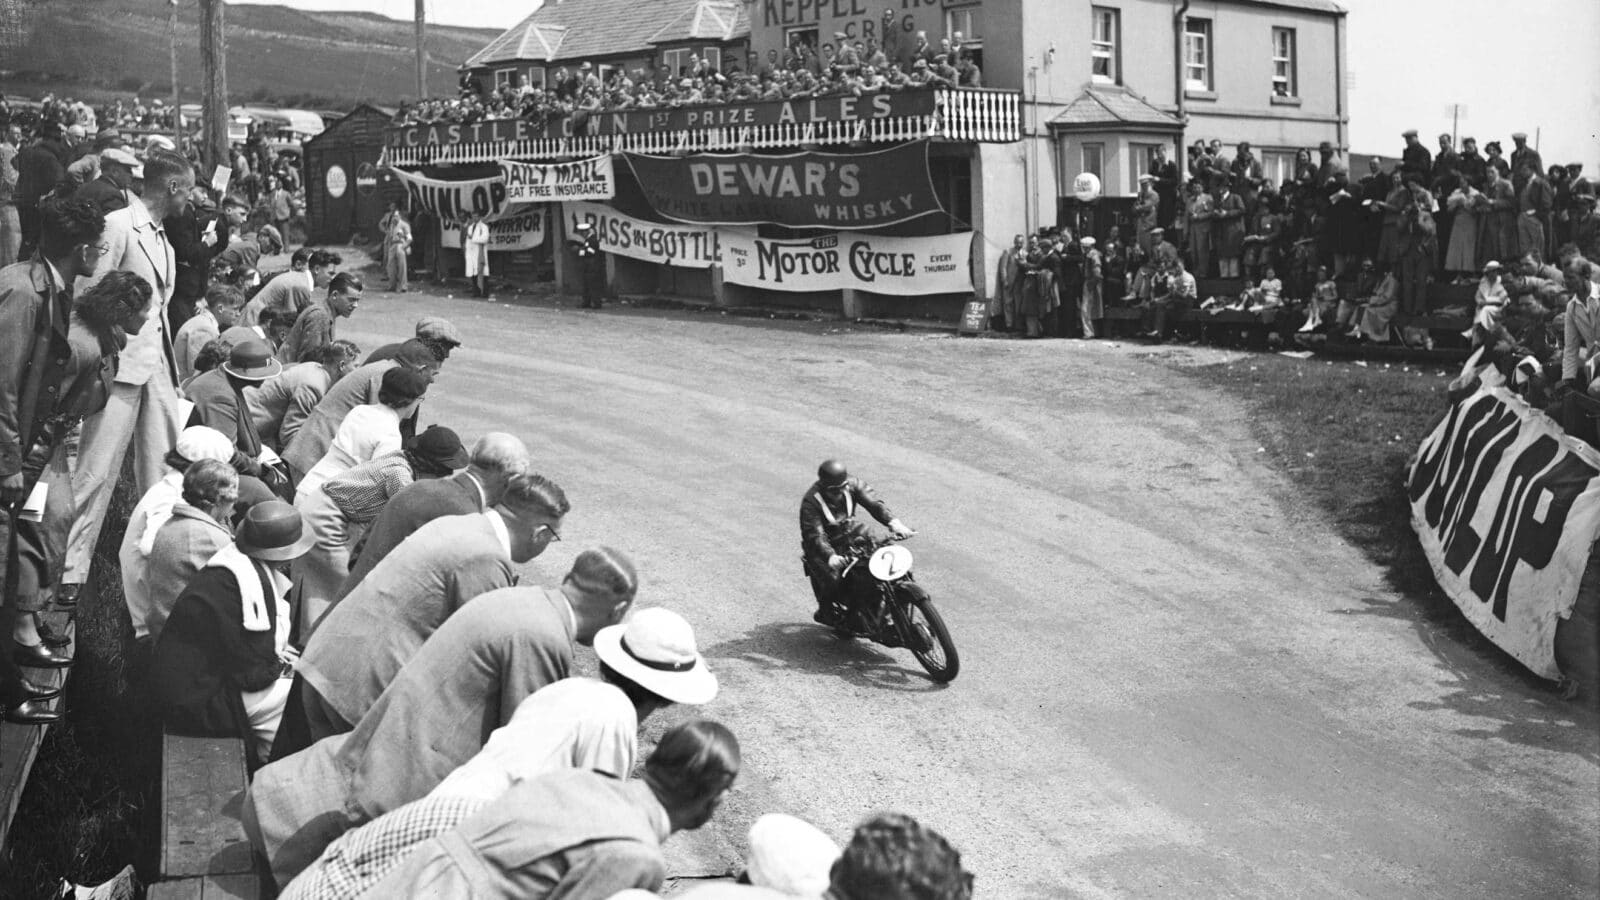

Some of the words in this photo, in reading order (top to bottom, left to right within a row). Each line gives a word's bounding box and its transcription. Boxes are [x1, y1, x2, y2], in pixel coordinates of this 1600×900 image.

[844, 14, 914, 39] CRG
[406, 112, 628, 146] CASTLEOWN
[687, 107, 756, 127] PRIZE
[778, 94, 892, 124] ALES
[554, 160, 606, 184] MAIL
[689, 162, 860, 198] DEWAR'S
[529, 185, 552, 197] FREE
[555, 182, 609, 196] INSURANCE
[814, 193, 914, 221] WHISKY
[585, 211, 632, 249] BASS
[633, 228, 647, 247] IN
[649, 227, 722, 262] BOTTLE
[813, 236, 838, 248] THE
[730, 246, 749, 257] PRICE
[755, 239, 841, 283] MOTOR
[850, 240, 916, 282] CYCLE
[929, 254, 953, 263] EVERY
[923, 263, 957, 273] THURSDAY
[1408, 394, 1600, 624] DUNLOP
[881, 550, 903, 577] 2
